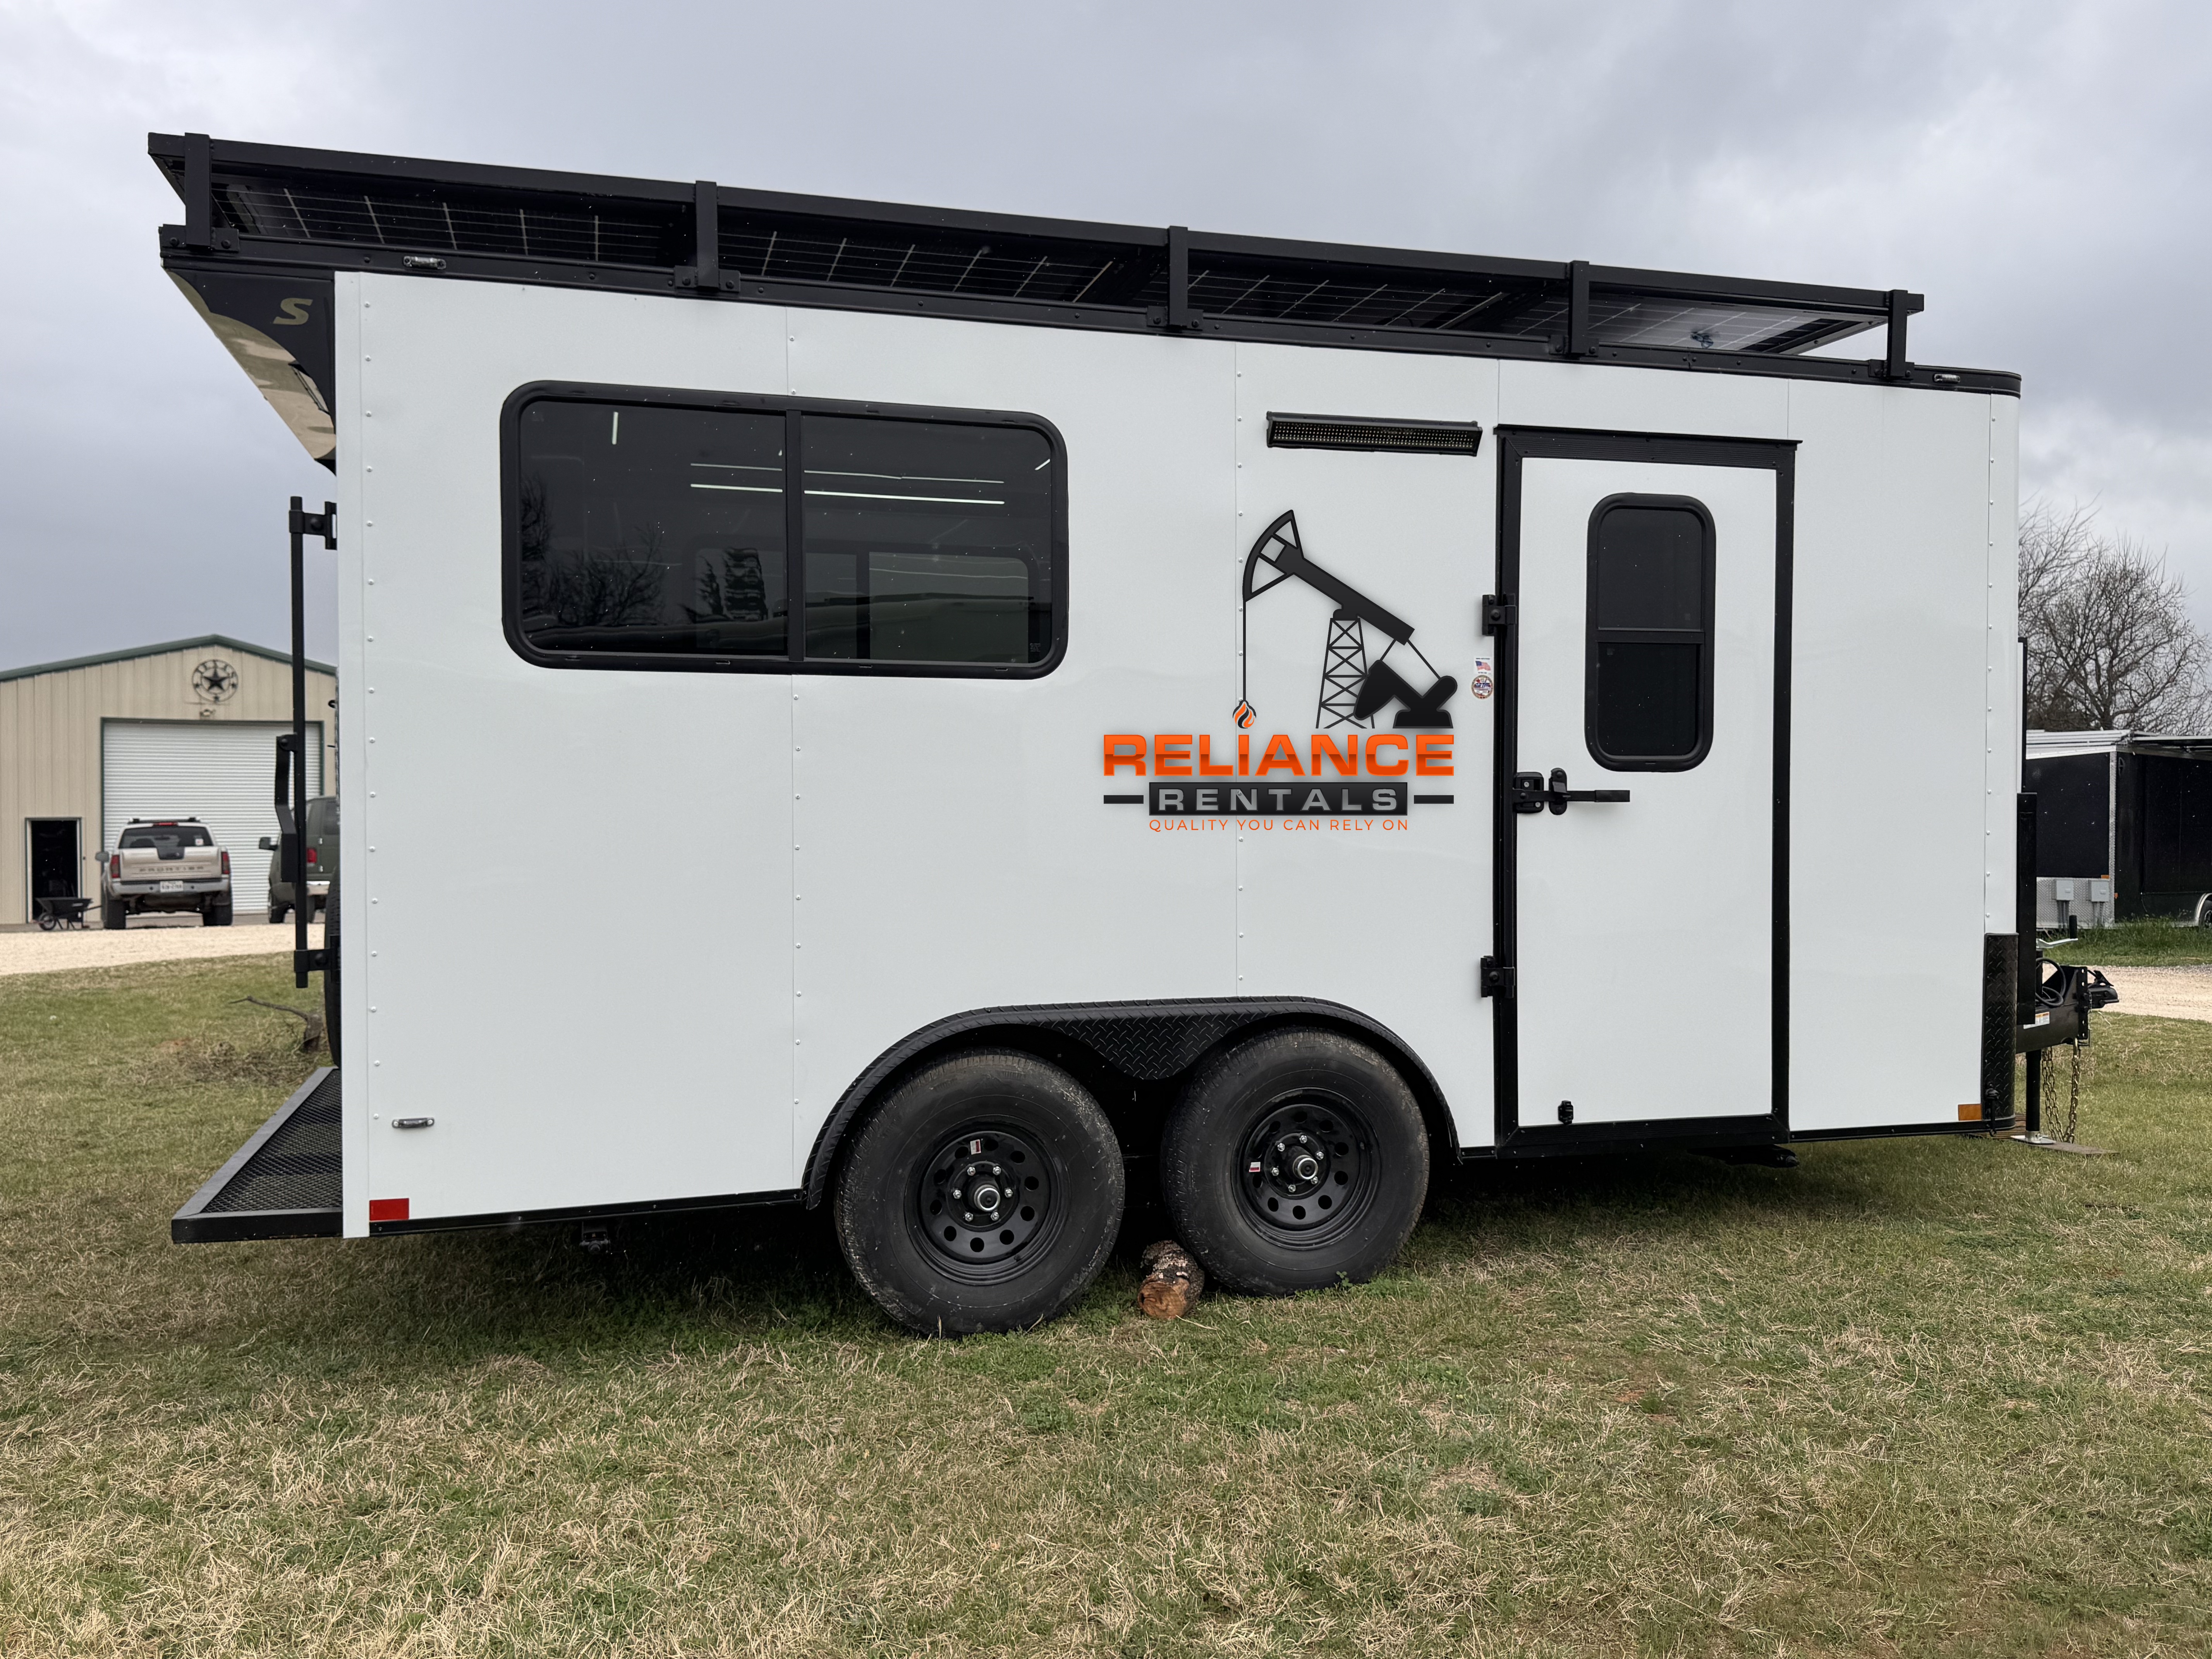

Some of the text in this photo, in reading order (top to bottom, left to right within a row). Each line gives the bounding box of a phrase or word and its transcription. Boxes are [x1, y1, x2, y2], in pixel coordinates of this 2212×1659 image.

[273, 298, 313, 325] S
[1104, 734, 1454, 776] RELIANCE
[1159, 789, 1397, 811] RENTALS
[1149, 819, 1407, 832] QUALITY YOU CAN RELY ON
